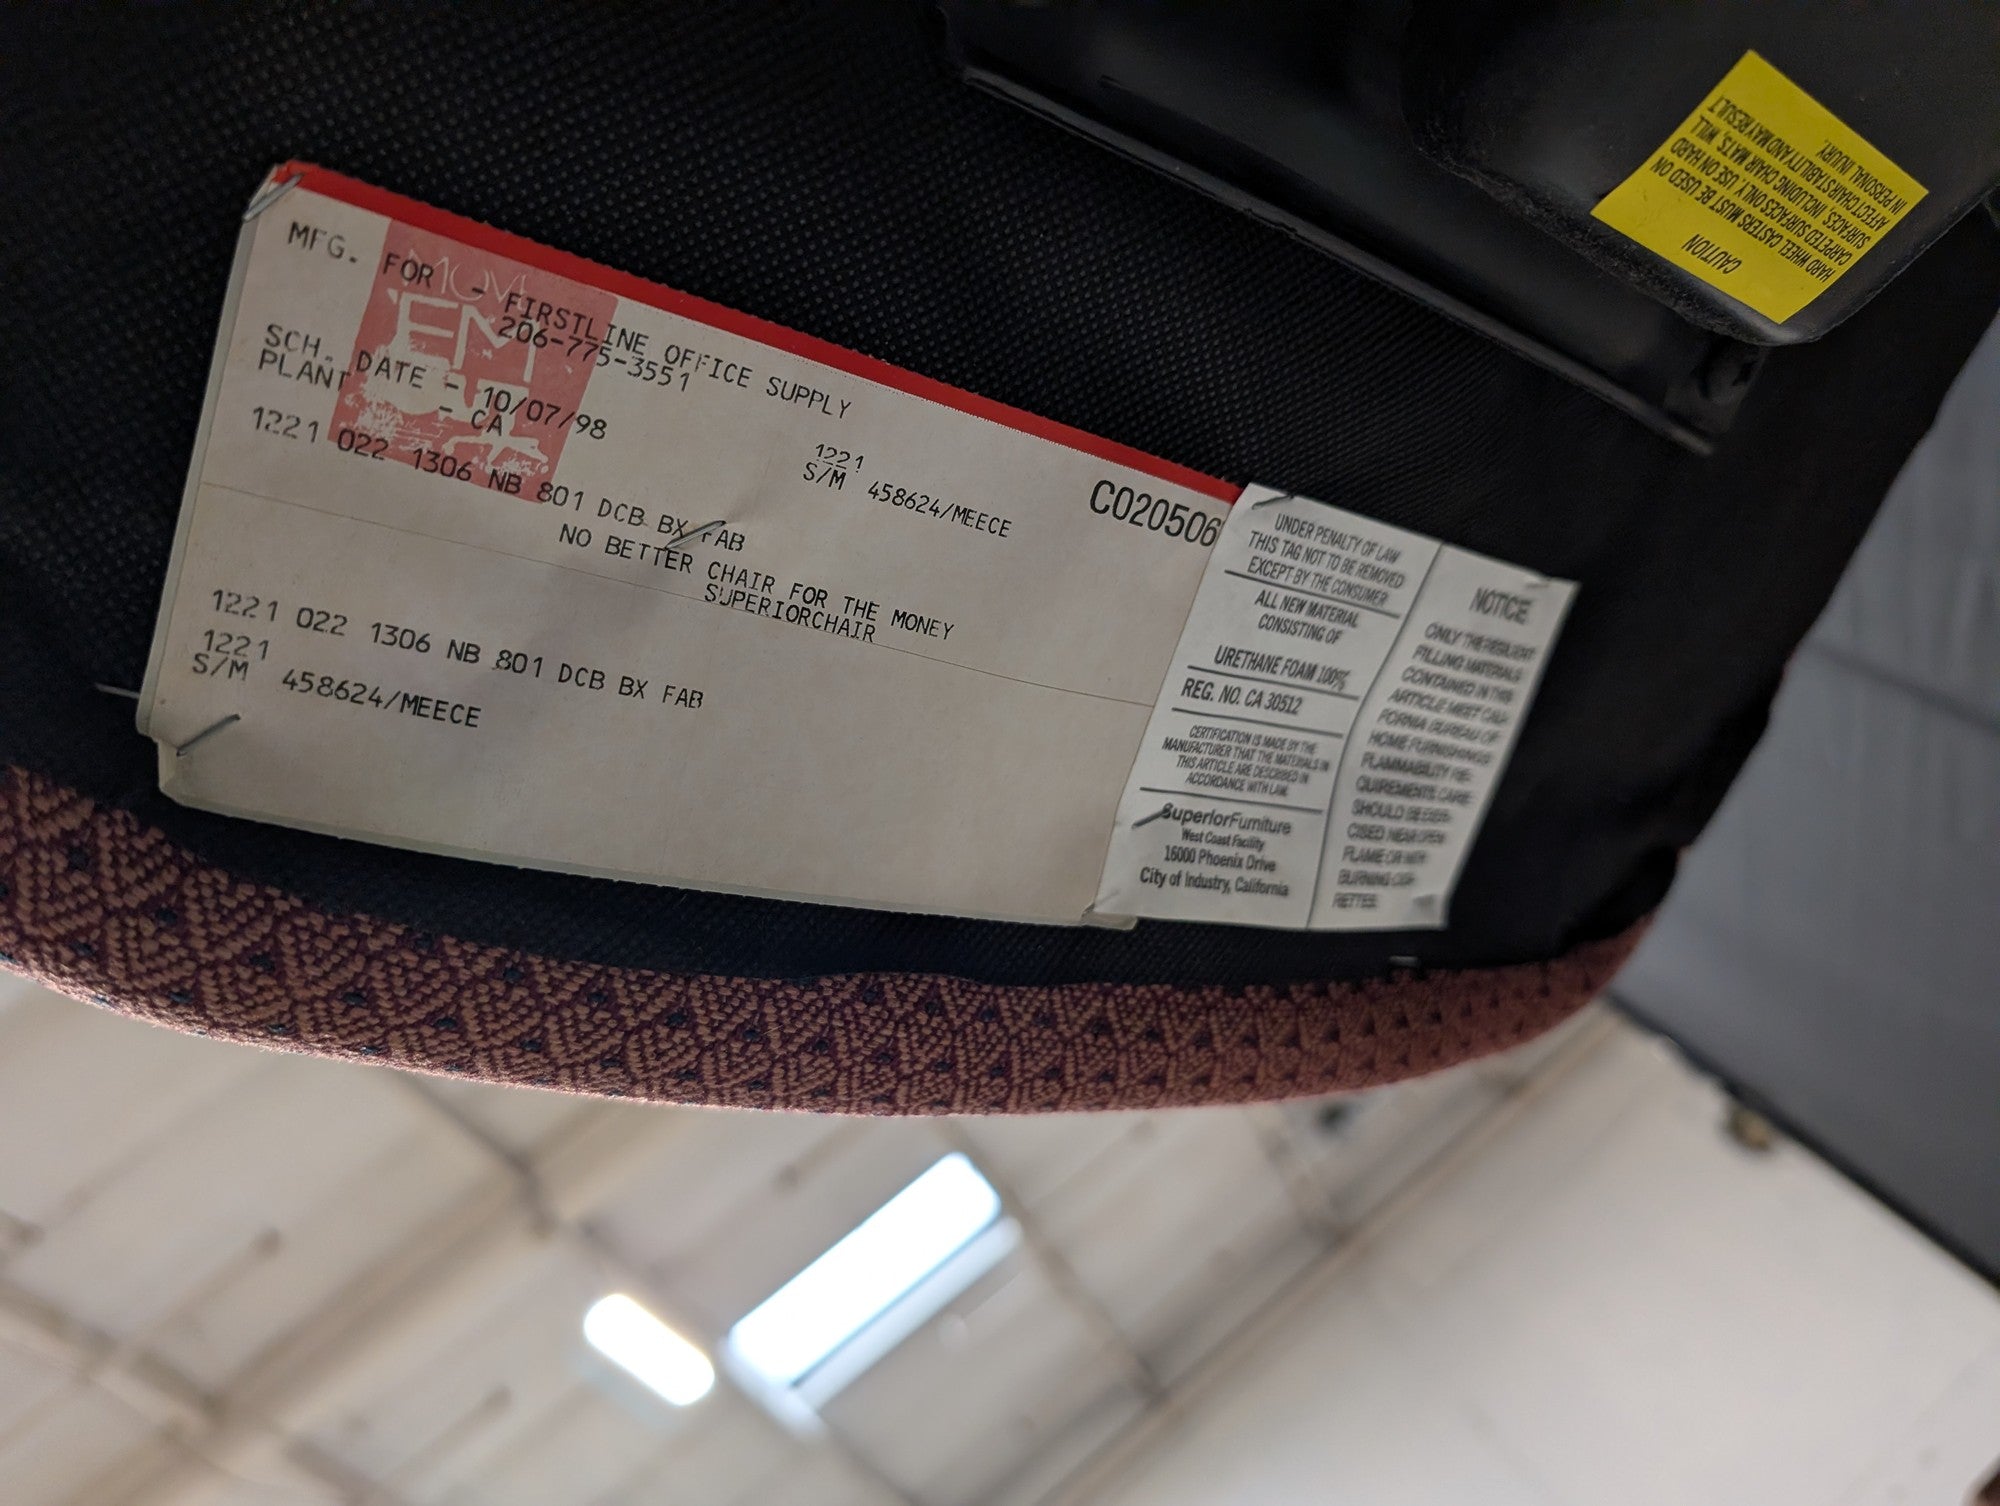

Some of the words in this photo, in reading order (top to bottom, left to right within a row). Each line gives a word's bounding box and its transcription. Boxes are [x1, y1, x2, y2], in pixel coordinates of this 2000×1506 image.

[1690, 114, 1722, 145] WILL
[1707, 95, 1755, 134] RESULT
[1716, 131, 1752, 166] MATS,
[1742, 120, 1775, 148] MAY
[1766, 137, 1795, 162] AND
[1650, 156, 1675, 177] ON
[1670, 137, 1707, 166] HARD
[1697, 155, 1721, 176] ON
[1815, 140, 1856, 176] INJURY.
[1668, 168, 1703, 196] USED
[1712, 165, 1740, 190] USE
[1744, 154, 1780, 185] CHAIR
[1782, 150, 1837, 193] STABILITY
[1694, 185, 1717, 205] BE
[1733, 178, 1768, 208] ONLY.
[1772, 174, 1828, 219] INCLUDING
[1827, 182, 1861, 211] CHAIR
[1848, 165, 1898, 208] PERSONAL
[1708, 195, 1747, 223] MUST
[1759, 198, 1812, 238] SURFACES
[1849, 198, 1891, 231] AFFECT
[1888, 198, 1908, 215] IN
[1737, 213, 1784, 248] CASTERS
[1822, 206, 1875, 249] SURFACES,
[1681, 234, 1742, 274] CAUTION
[1778, 238, 1815, 268] WHEEL
[1803, 229, 1853, 266] CARPETED
[1805, 259, 1837, 282] HARD
[288, 221, 357, 263] MFG.
[383, 253, 433, 288] FOR
[504, 292, 649, 356] FIRSTLINE
[664, 344, 752, 388] OFFICE
[766, 377, 851, 419] SUPPLY
[498, 317, 690, 392] 206-775-3551
[259, 349, 351, 392] PLANT
[471, 410, 503, 437] CA
[266, 324, 333, 361] SCH.
[356, 350, 427, 389] DATE
[484, 387, 607, 440] 10/07/98
[253, 406, 320, 443] 1221
[337, 428, 389, 460] 022
[414, 447, 472, 481] 1306
[488, 469, 522, 495] NB
[536, 482, 584, 511] 801
[597, 497, 645, 526] DCB
[657, 514, 690, 538] BX
[815, 443, 864, 474] 1221
[803, 461, 847, 490] S/M
[868, 480, 1012, 539] 458624/MEECE
[1089, 479, 1225, 548] C020506
[1274, 513, 1315, 540] UNDER
[1314, 526, 1363, 553] PENALTY
[1361, 541, 1378, 558] OF
[1375, 548, 1401, 564] LAW
[1248, 530, 1279, 553] THIS
[1280, 540, 1303, 560] TAG
[1301, 547, 1326, 566] NOT
[1326, 553, 1342, 570] TO
[1341, 558, 1358, 575] BE
[1356, 563, 1406, 589] REMOVED
[559, 523, 592, 548] NO
[605, 535, 693, 574] BETTER
[707, 560, 775, 594] CHAIR
[789, 582, 828, 609] FOR
[844, 595, 880, 621] THE
[892, 608, 955, 641] MONEY
[1247, 556, 1295, 581] EXCEPT
[1293, 569, 1311, 586] BY
[1310, 572, 1331, 592] THE
[1331, 578, 1389, 607] CONSUMER
[704, 583, 876, 643] SUPERIORCHAIR
[1254, 589, 1278, 610] ALL
[1280, 594, 1308, 614] NEW
[1305, 600, 1359, 628] MATERIAL
[1470, 588, 1532, 625] NOTICE
[203, 629, 269, 660] 1221
[1258, 612, 1326, 641] CONSISTING
[1325, 628, 1343, 645] OF
[1424, 622, 1462, 645] ONLY
[212, 589, 279, 622] 1221
[296, 607, 347, 636] 022
[370, 622, 432, 654] 1306
[446, 640, 482, 664] NB
[494, 650, 544, 678] 801
[558, 663, 606, 691] DCB
[618, 676, 649, 699] BX
[662, 684, 704, 709] FAB
[1412, 644, 1464, 670] FILLING
[1214, 645, 1282, 675] URETHANE
[1280, 658, 1318, 681] FOAM
[1316, 665, 1349, 690] 100%
[192, 653, 249, 680] S/M
[281, 669, 482, 729] 458624/MEECE
[1181, 677, 1214, 701] REG.
[1218, 685, 1241, 705] NO.
[1244, 689, 1263, 709] CA
[1264, 692, 1303, 715] 30512
[1162, 736, 1235, 757] MANUFACTURER
[1233, 746, 1255, 761] THAT
[1256, 749, 1275, 764] THE
[1189, 725, 1252, 746] CERTIFICATION
[1250, 734, 1262, 747] IS
[1262, 735, 1286, 750] MADE
[1177, 755, 1200, 769] THIS
[1197, 757, 1236, 773] ARTICLE
[1236, 762, 1253, 776] ARE
[1185, 772, 1246, 792] ACCORDANCE
[1160, 803, 1292, 834] SuperiorFurniture
[1181, 828, 1204, 843] West
[1205, 831, 1232, 848] Coast
[1231, 834, 1265, 853] Facility
[1164, 845, 1197, 864] 16000
[1197, 849, 1244, 868] Phoenix
[1245, 853, 1277, 871] Drive
[1140, 867, 1166, 888] City
[1170, 870, 1182, 887] of
[1184, 871, 1230, 894] Industry,
[1234, 876, 1290, 897] California
